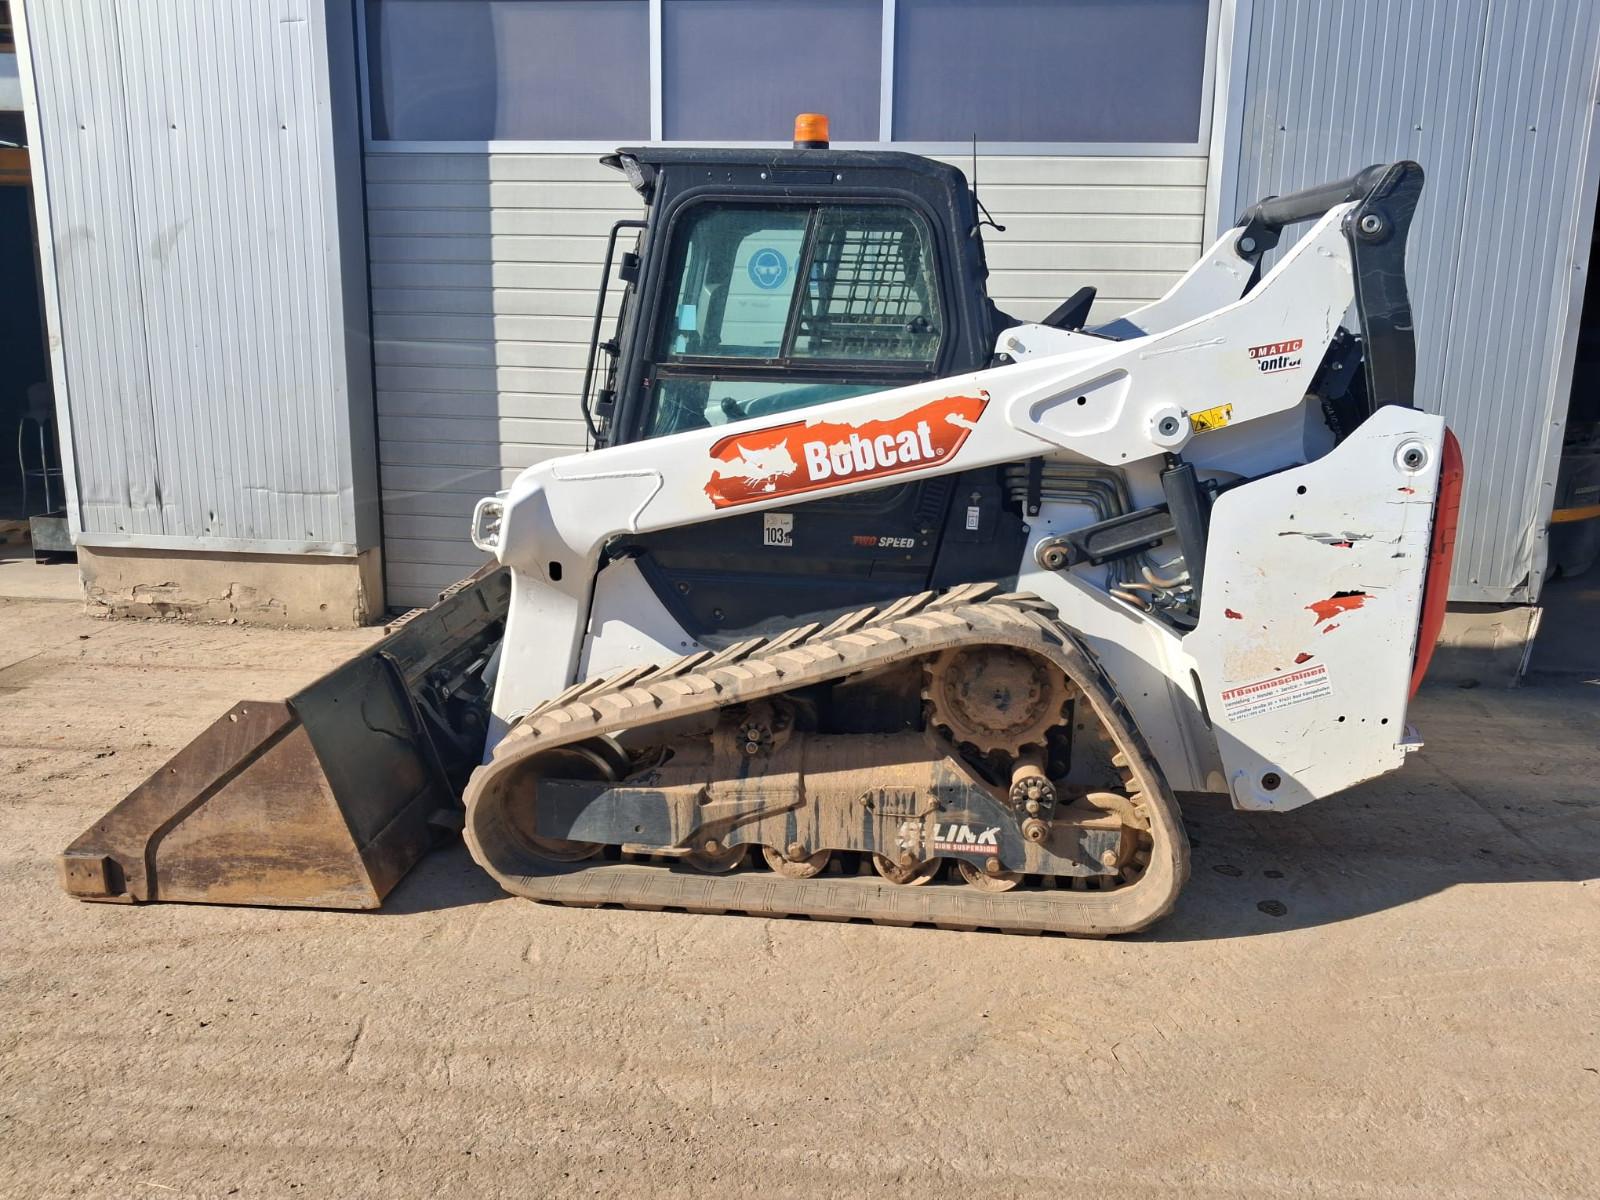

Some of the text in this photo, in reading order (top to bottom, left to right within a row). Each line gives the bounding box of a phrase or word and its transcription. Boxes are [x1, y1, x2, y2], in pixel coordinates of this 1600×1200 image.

[803, 420, 935, 481] Bobcat
[765, 527, 784, 543] 103
[878, 536, 915, 548] SPEED
